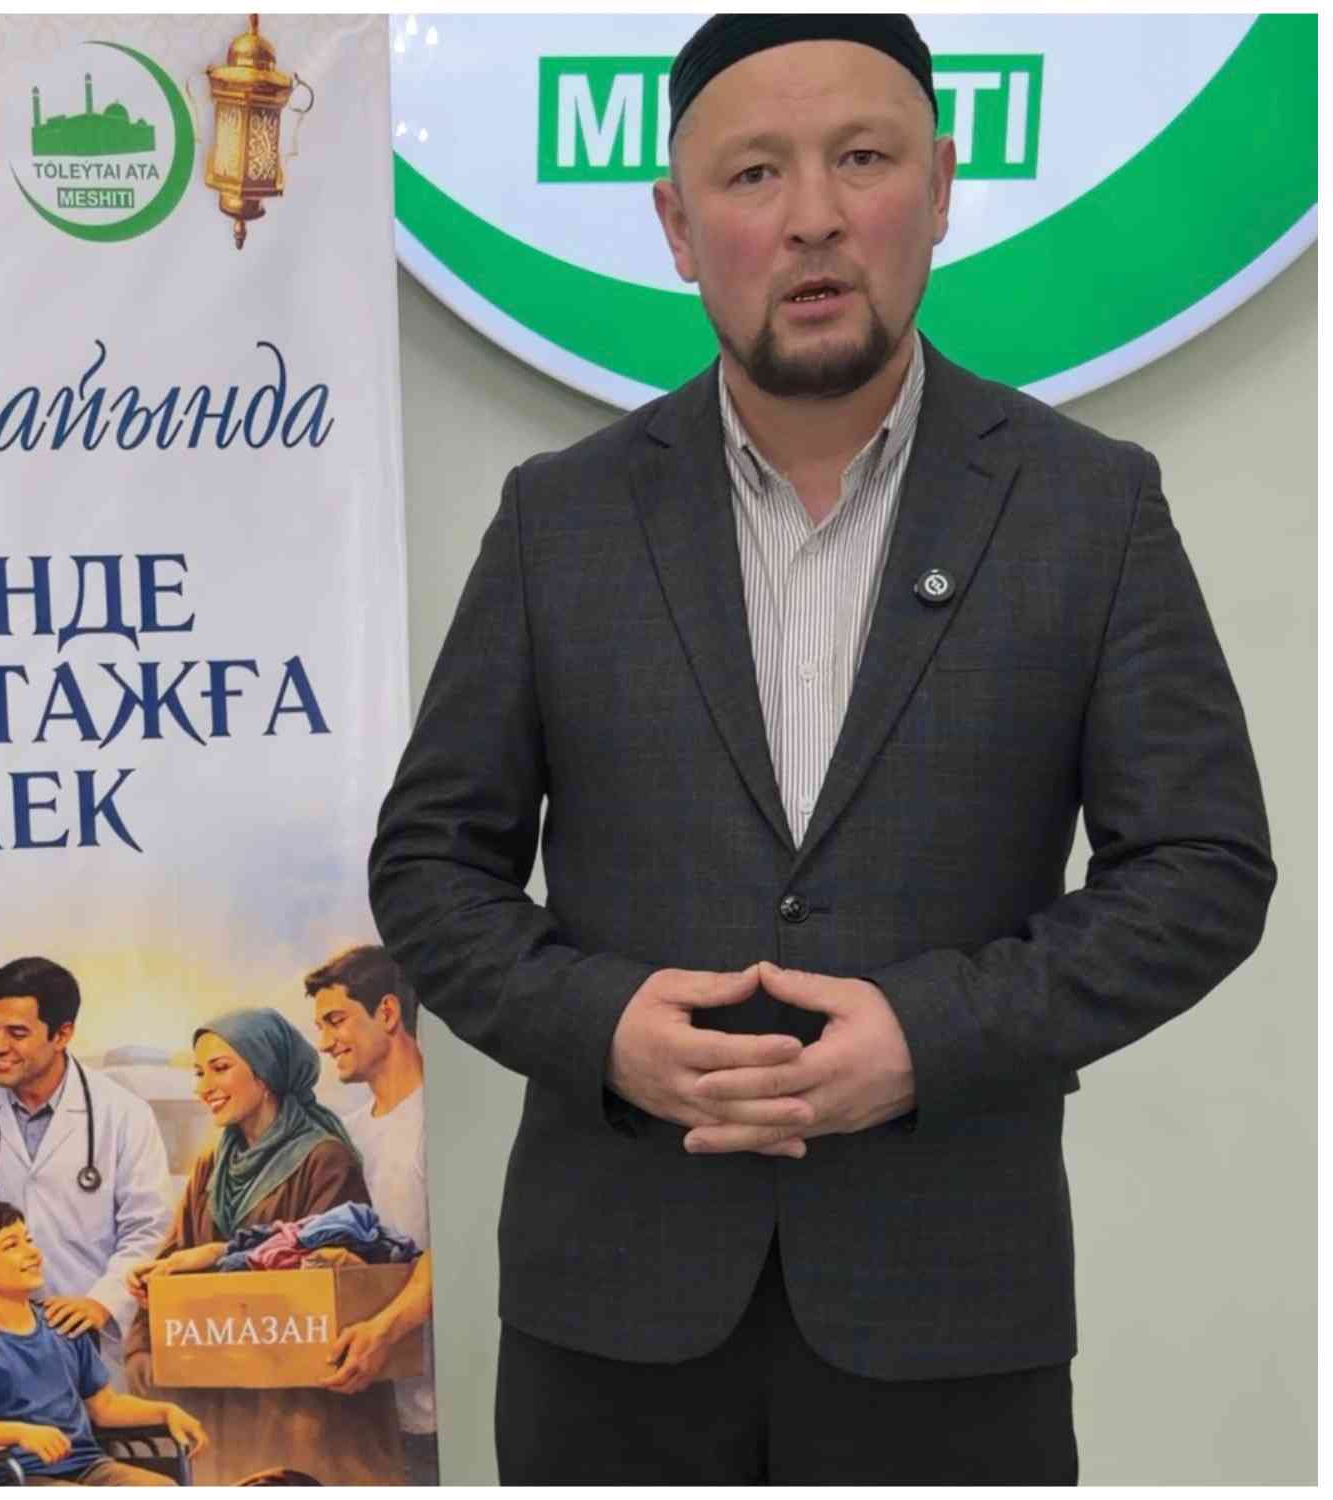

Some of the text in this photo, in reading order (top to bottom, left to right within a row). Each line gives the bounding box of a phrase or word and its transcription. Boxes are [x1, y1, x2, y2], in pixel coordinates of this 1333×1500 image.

[125, 163, 160, 180] ATA
[59, 190, 134, 207] MESHITI
[164, 1313, 330, 1347] РАМАЗАН
